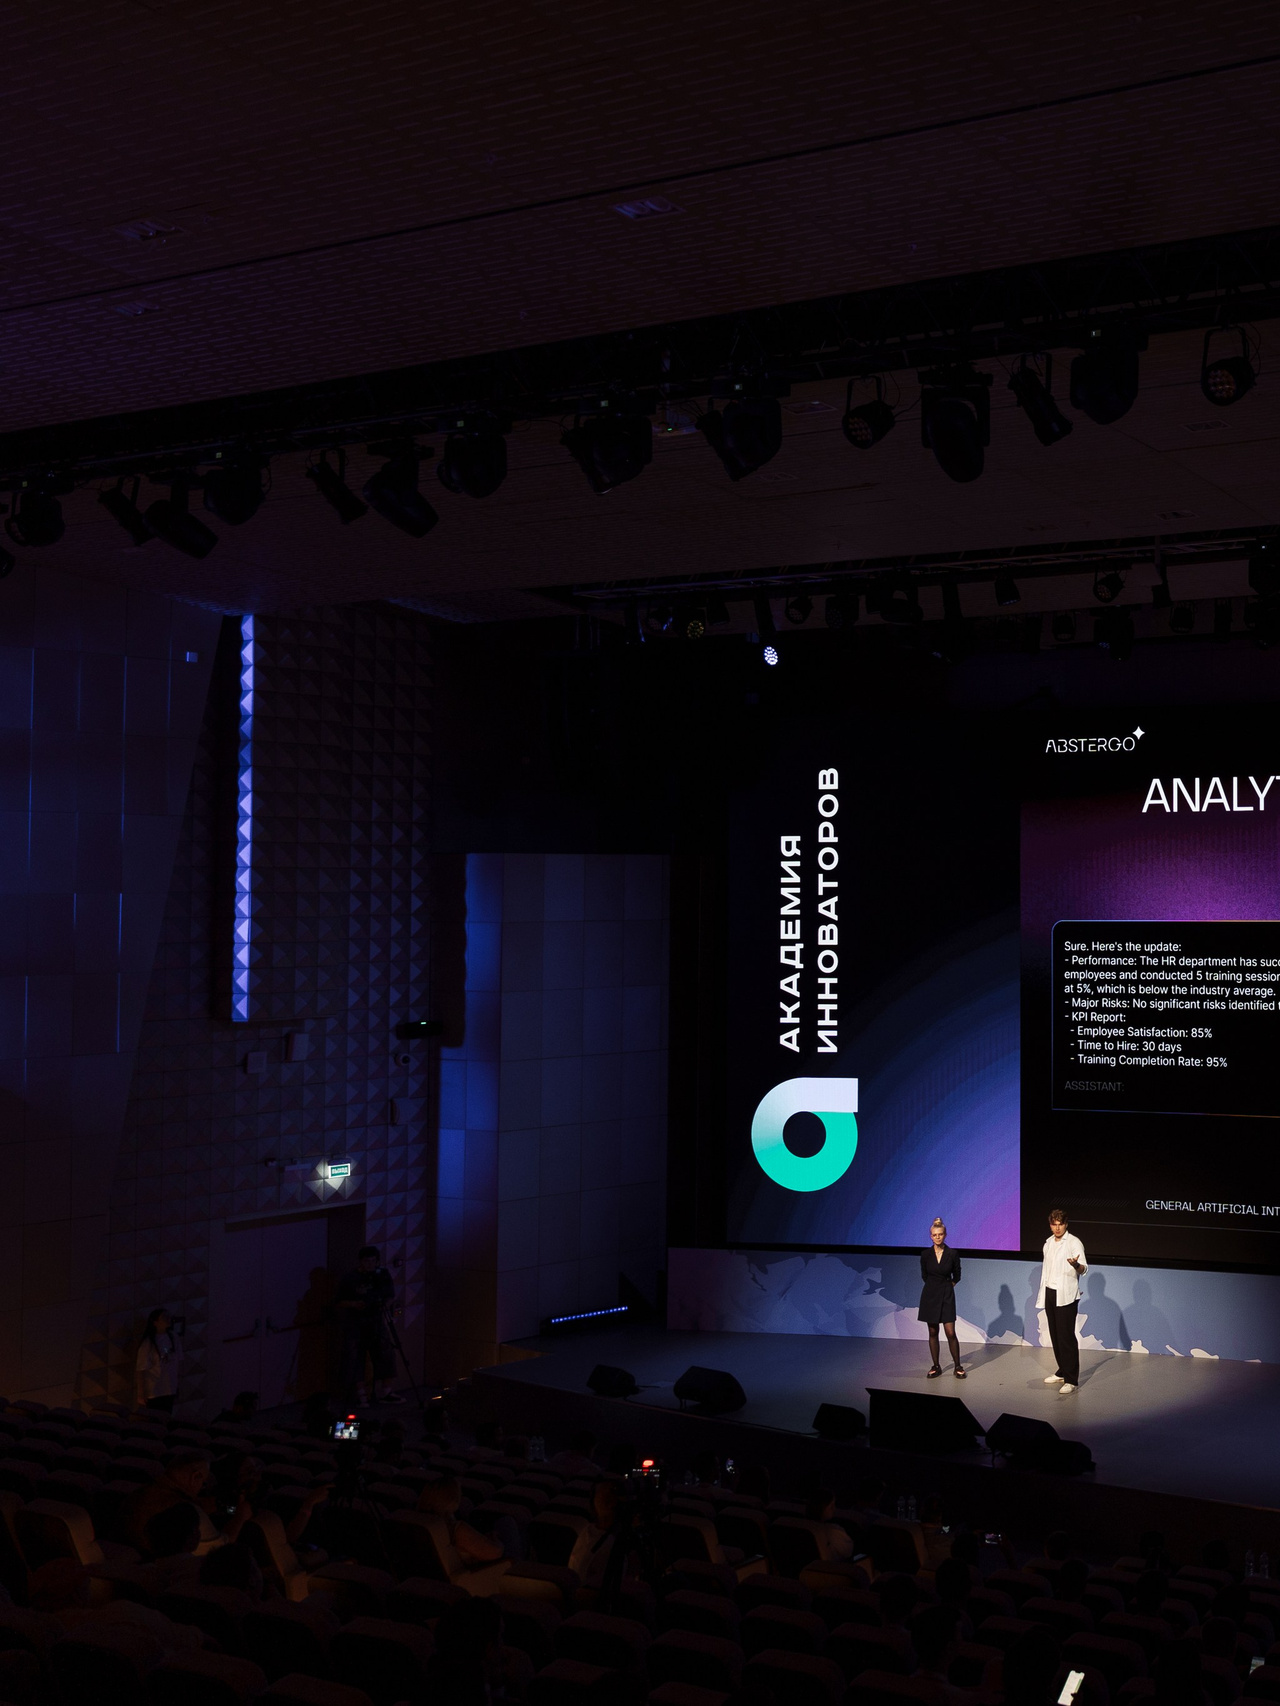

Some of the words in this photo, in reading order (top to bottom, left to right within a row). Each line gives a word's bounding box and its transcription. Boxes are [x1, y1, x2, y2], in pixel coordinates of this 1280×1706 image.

[1046, 737, 1135, 753] ABSTERGO
[817, 766, 840, 1054] ИННОВАТОРОВ
[779, 834, 804, 1054] АКАДЕМИЯ
[1065, 941, 1089, 951] Sure.
[1092, 942, 1122, 951] Here's
[1126, 942, 1141, 951] the
[1144, 942, 1181, 953] update:
[1072, 955, 1136, 965] Performance:
[1140, 956, 1158, 965] The
[1162, 956, 1176, 965] HR
[1179, 957, 1236, 968] department
[1235, 957, 1257, 966] has
[1064, 970, 1116, 981] employees
[1119, 970, 1137, 979] and
[1140, 971, 1193, 980] conducted
[1197, 971, 1202, 980] 5
[1206, 971, 1242, 983] training
[1064, 985, 1073, 993] at
[1077, 984, 1093, 995] 5%,
[1097, 984, 1125, 993] which
[1128, 984, 1136, 994] is
[1139, 985, 1168, 994] below
[1171, 985, 1187, 994] the
[1191, 985, 1230, 997] industry
[1234, 988, 1276, 999] average.
[1072, 998, 1099, 1009] Major
[1102, 998, 1129, 1008] Risks:
[1133, 999, 1147, 1008] No
[1150, 999, 1200, 1011] significant
[1203, 999, 1226, 1009] risks
[1229, 1000, 1274, 1010] identified
[1072, 1012, 1087, 1021] KPI
[1091, 1012, 1125, 1023] Report:
[1078, 1026, 1124, 1038] Employee
[1128, 1027, 1188, 1037] Satisfaction:
[1191, 1028, 1212, 1038] 85%
[1078, 1040, 1101, 1050] Time
[1104, 1042, 1114, 1050] to
[1117, 1041, 1139, 1050] Hire:
[1143, 1041, 1155, 1051] 30
[1158, 1042, 1181, 1054] days
[1078, 1054, 1116, 1067] Training
[1119, 1054, 1175, 1067] Completion
[1178, 1057, 1203, 1066] Rate:
[1207, 1057, 1227, 1067] 95%
[1146, 1200, 1194, 1211] GENERAL
[1197, 1203, 1258, 1215] ARTIFICIAL
